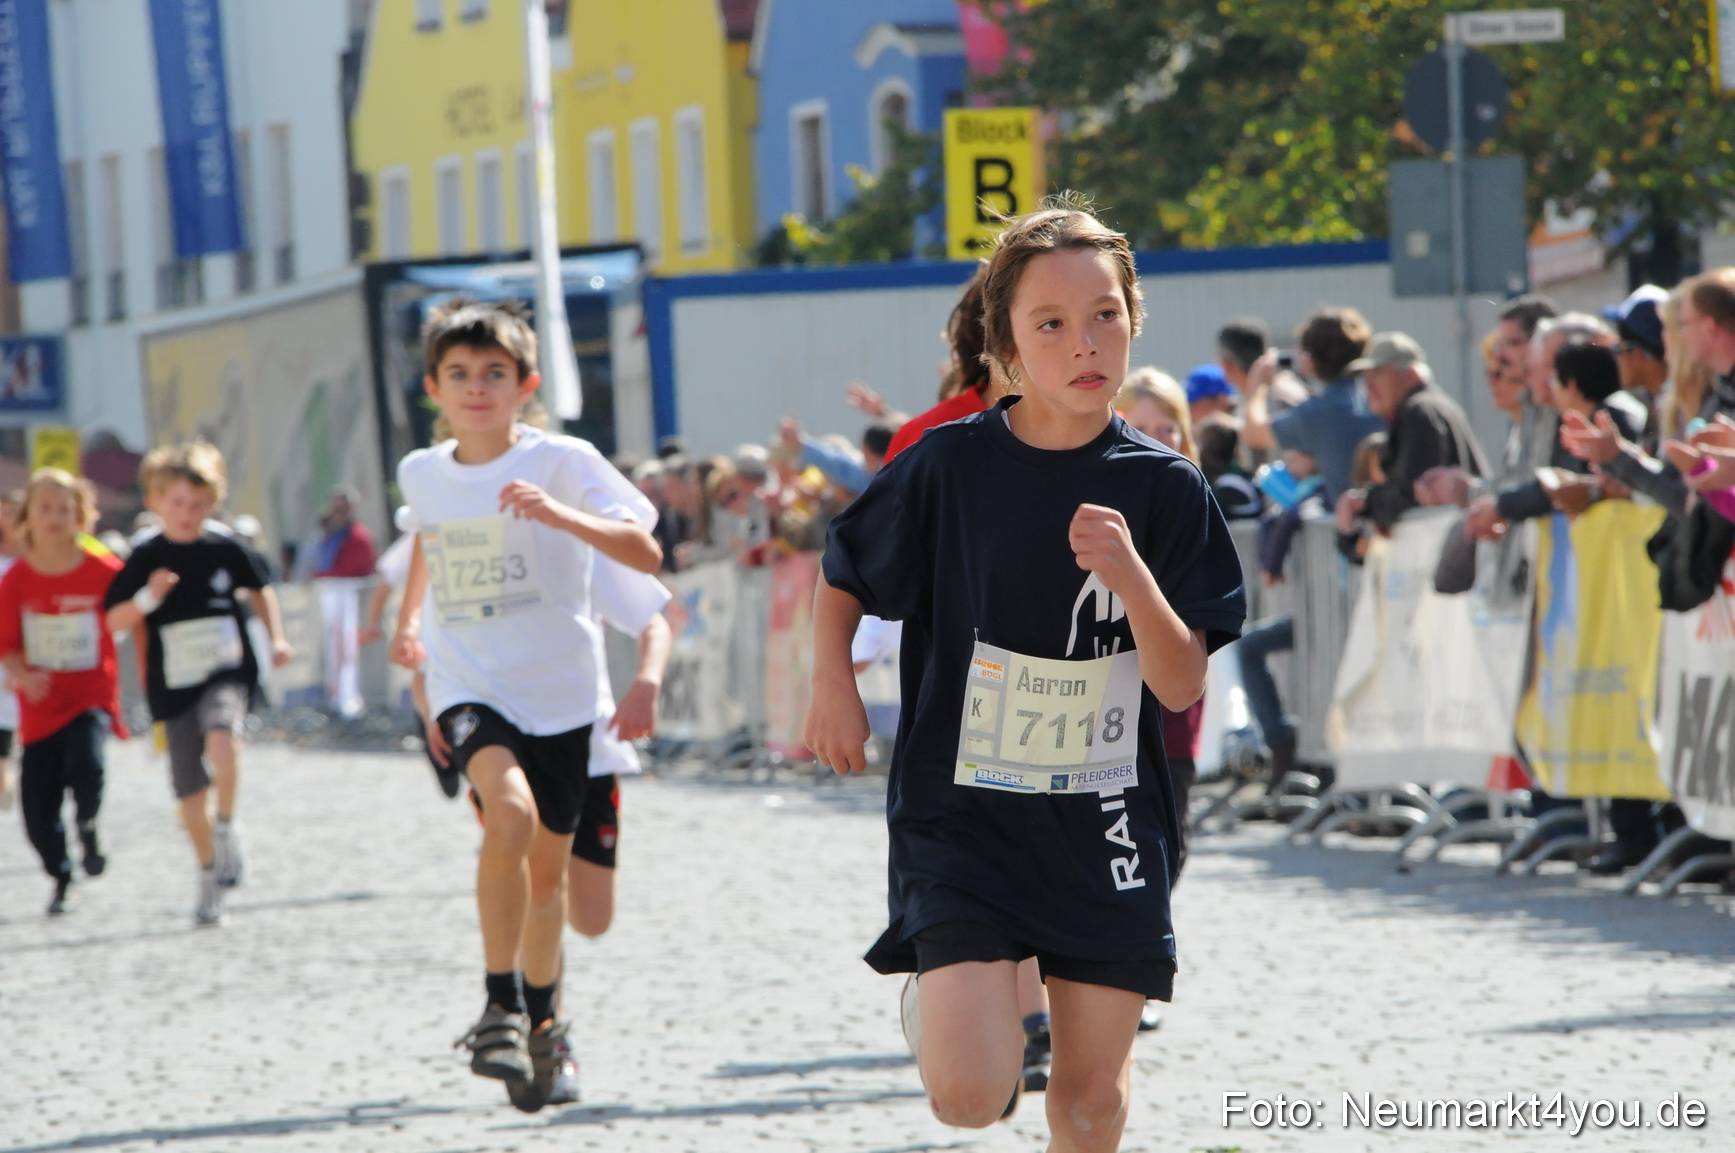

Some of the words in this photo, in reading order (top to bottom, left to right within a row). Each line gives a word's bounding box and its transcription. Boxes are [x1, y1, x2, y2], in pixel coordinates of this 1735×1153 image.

[957, 119, 1025, 142] Block
[975, 158, 1017, 222] B
[450, 554, 528, 589] 7253
[1016, 666, 1087, 697] Aaron
[971, 697, 983, 718] K
[1016, 706, 1125, 749] 7118
[975, 769, 1024, 784] BOCK
[1071, 764, 1133, 784] PFLEIDERER
